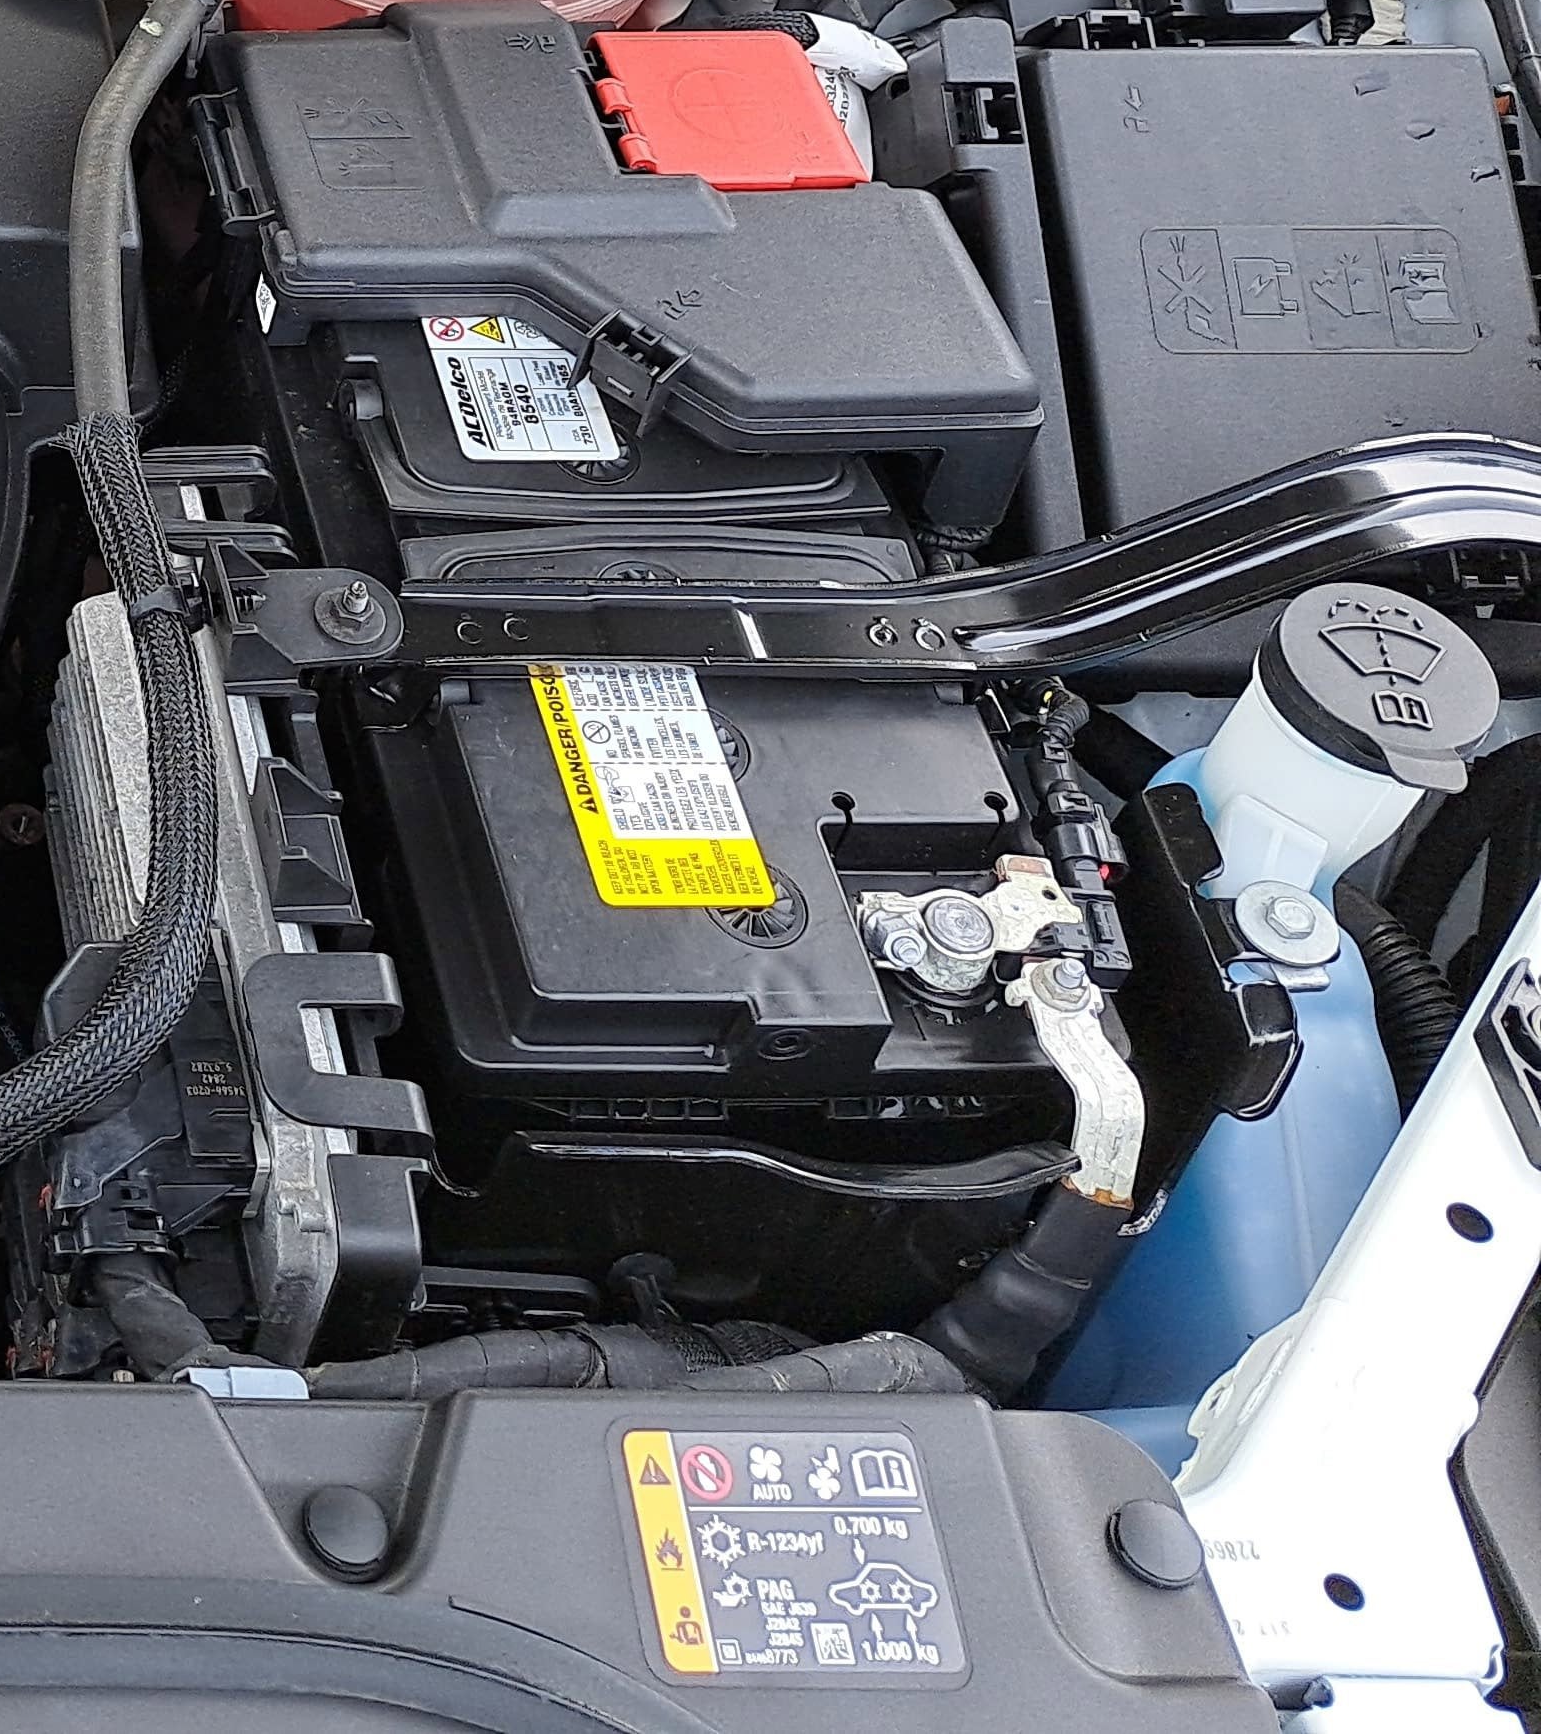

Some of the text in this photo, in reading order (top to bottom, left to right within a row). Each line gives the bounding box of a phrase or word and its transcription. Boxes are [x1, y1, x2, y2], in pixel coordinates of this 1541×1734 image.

[448, 356, 487, 446] ACDelco
[580, 425, 592, 444] 730
[753, 1484, 793, 1501] AUTO
[834, 1516, 909, 1539] 0.700 kg
[746, 1531, 824, 1556] R-1234yf
[756, 1579, 795, 1600] PAG
[862, 1640, 939, 1665] 1.000 kg
